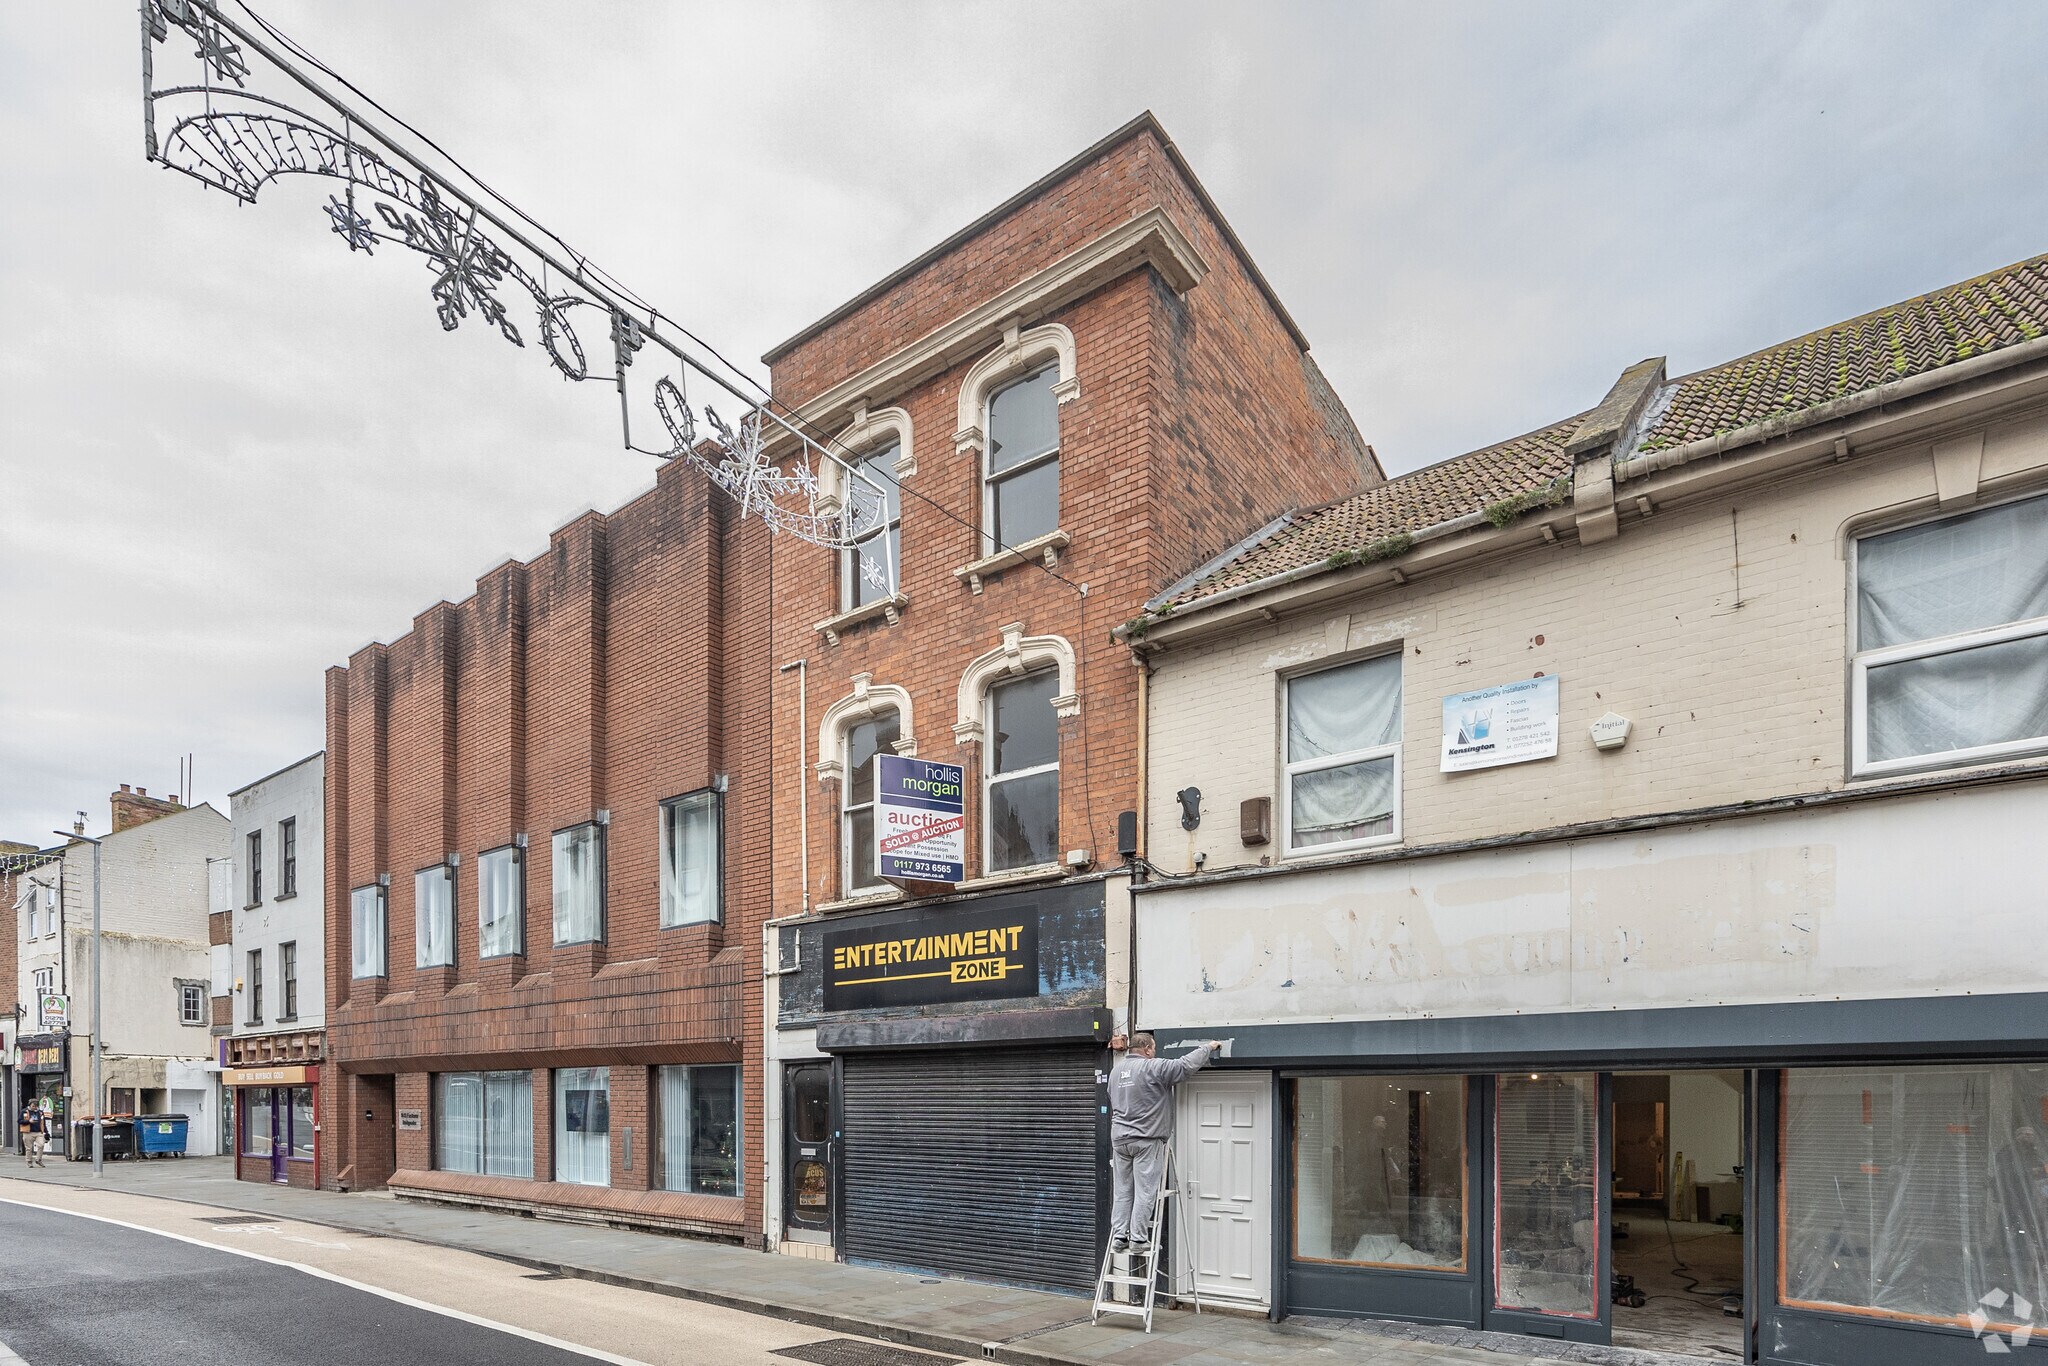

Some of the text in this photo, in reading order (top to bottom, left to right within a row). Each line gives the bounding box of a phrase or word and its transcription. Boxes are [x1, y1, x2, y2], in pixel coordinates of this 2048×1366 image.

[1461, 682, 1538, 703] Another Quality Installation by
[1448, 743, 1495, 755] Kensington
[925, 764, 960, 783] hollis
[903, 777, 960, 797] morgan
[888, 812, 948, 827] aucti
[885, 820, 960, 849] SOLD @ AUCTION
[914, 850, 930, 858] Mixed
[917, 844, 949, 853] Possession
[894, 860, 952, 873] 0117 973 6565
[900, 869, 945, 879] hollismorgan.co.uk
[834, 925, 1024, 970] ENTERTAINMENT
[956, 960, 1000, 980] ZONE
